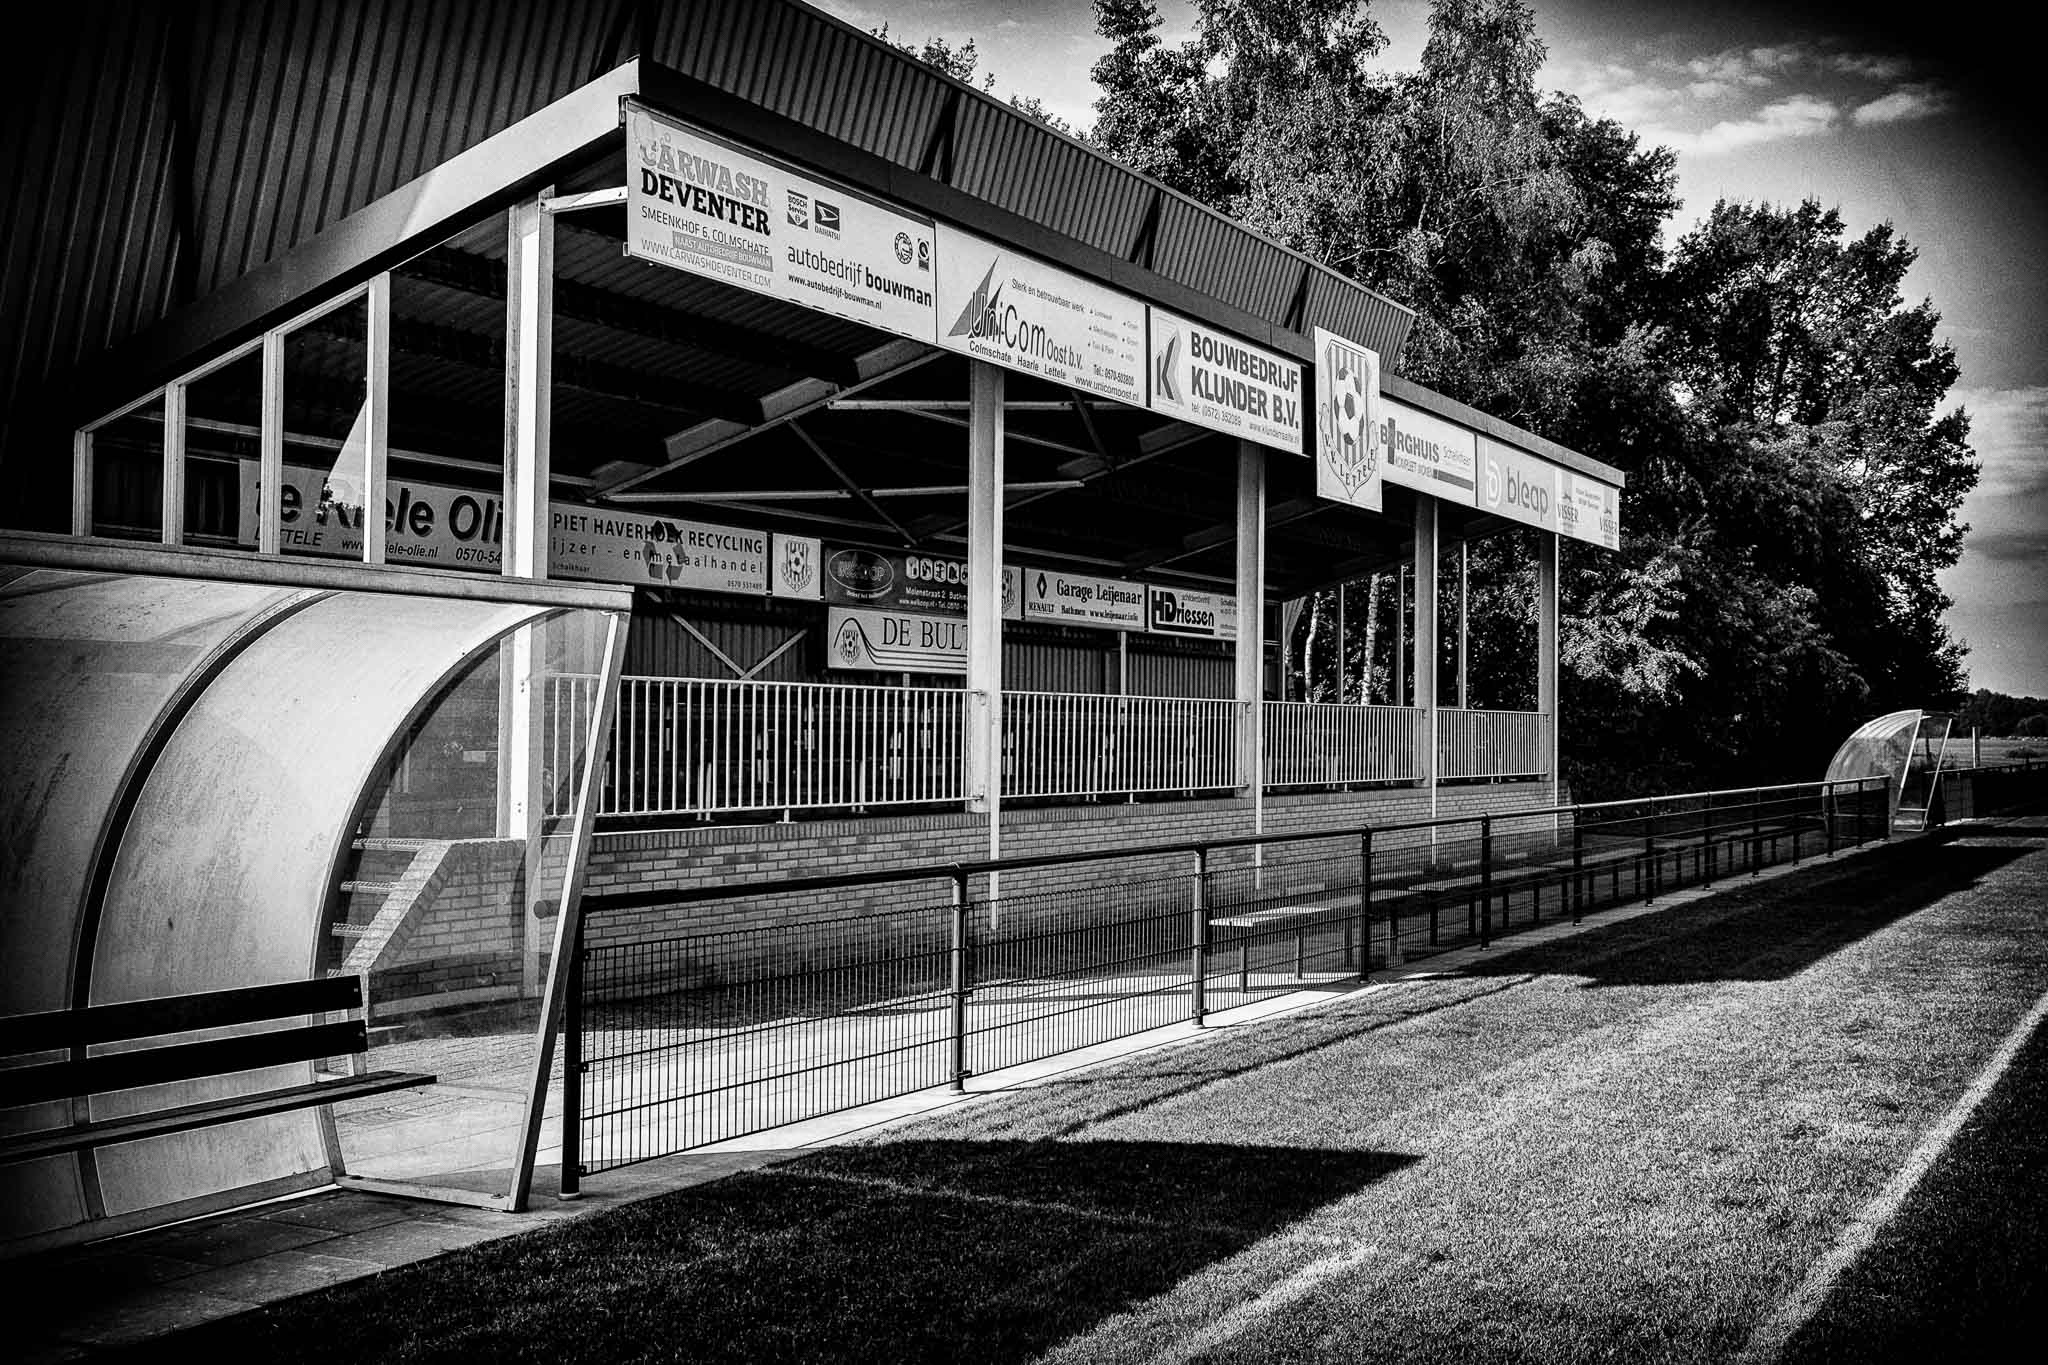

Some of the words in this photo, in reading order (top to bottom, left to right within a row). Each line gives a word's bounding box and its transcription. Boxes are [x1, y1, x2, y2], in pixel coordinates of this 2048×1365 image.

[639, 141, 769, 207] CARWASH
[641, 167, 771, 236] DEVENTER
[787, 195, 808, 208] BOSCH
[788, 203, 808, 217] Service
[641, 205, 700, 234] SMEENKHOF
[712, 229, 769, 256] COLMSCHATE
[814, 225, 841, 241] DAIHATSU
[641, 239, 771, 288] WWW.CARWASHDEVENTER.COM
[787, 245, 862, 288] autobedrijf
[865, 266, 932, 307] bouwman
[788, 273, 882, 310] www.autobedrijf-bouwman.nl
[1011, 278, 1027, 292] Sterk
[1028, 286, 1036, 297] en
[1071, 301, 1085, 313] werk
[969, 341, 1012, 363] Colmschate
[1017, 355, 1039, 372] Haarle
[1044, 363, 1067, 379] Lettele
[1191, 331, 1298, 392] BOUWBEDRIJF
[1075, 376, 1139, 401] www.unicomoost.nl
[1191, 365, 1268, 420] KLUNDER
[1273, 394, 1299, 430] B.V.
[1340, 448, 1375, 487] LETTELE
[1507, 464, 1549, 521] bleap
[552, 537, 597, 556] ijzer
[623, 549, 641, 560] en
[553, 513, 588, 532] PIET
[688, 530, 763, 554] RECYCLING
[905, 586, 941, 598] Molenstraat
[949, 591, 967, 600] Bathm
[1028, 602, 1055, 613] RENAULT
[1056, 578, 1093, 603] Garage
[1095, 584, 1142, 606] Leijenaar
[881, 617, 912, 647] DE
